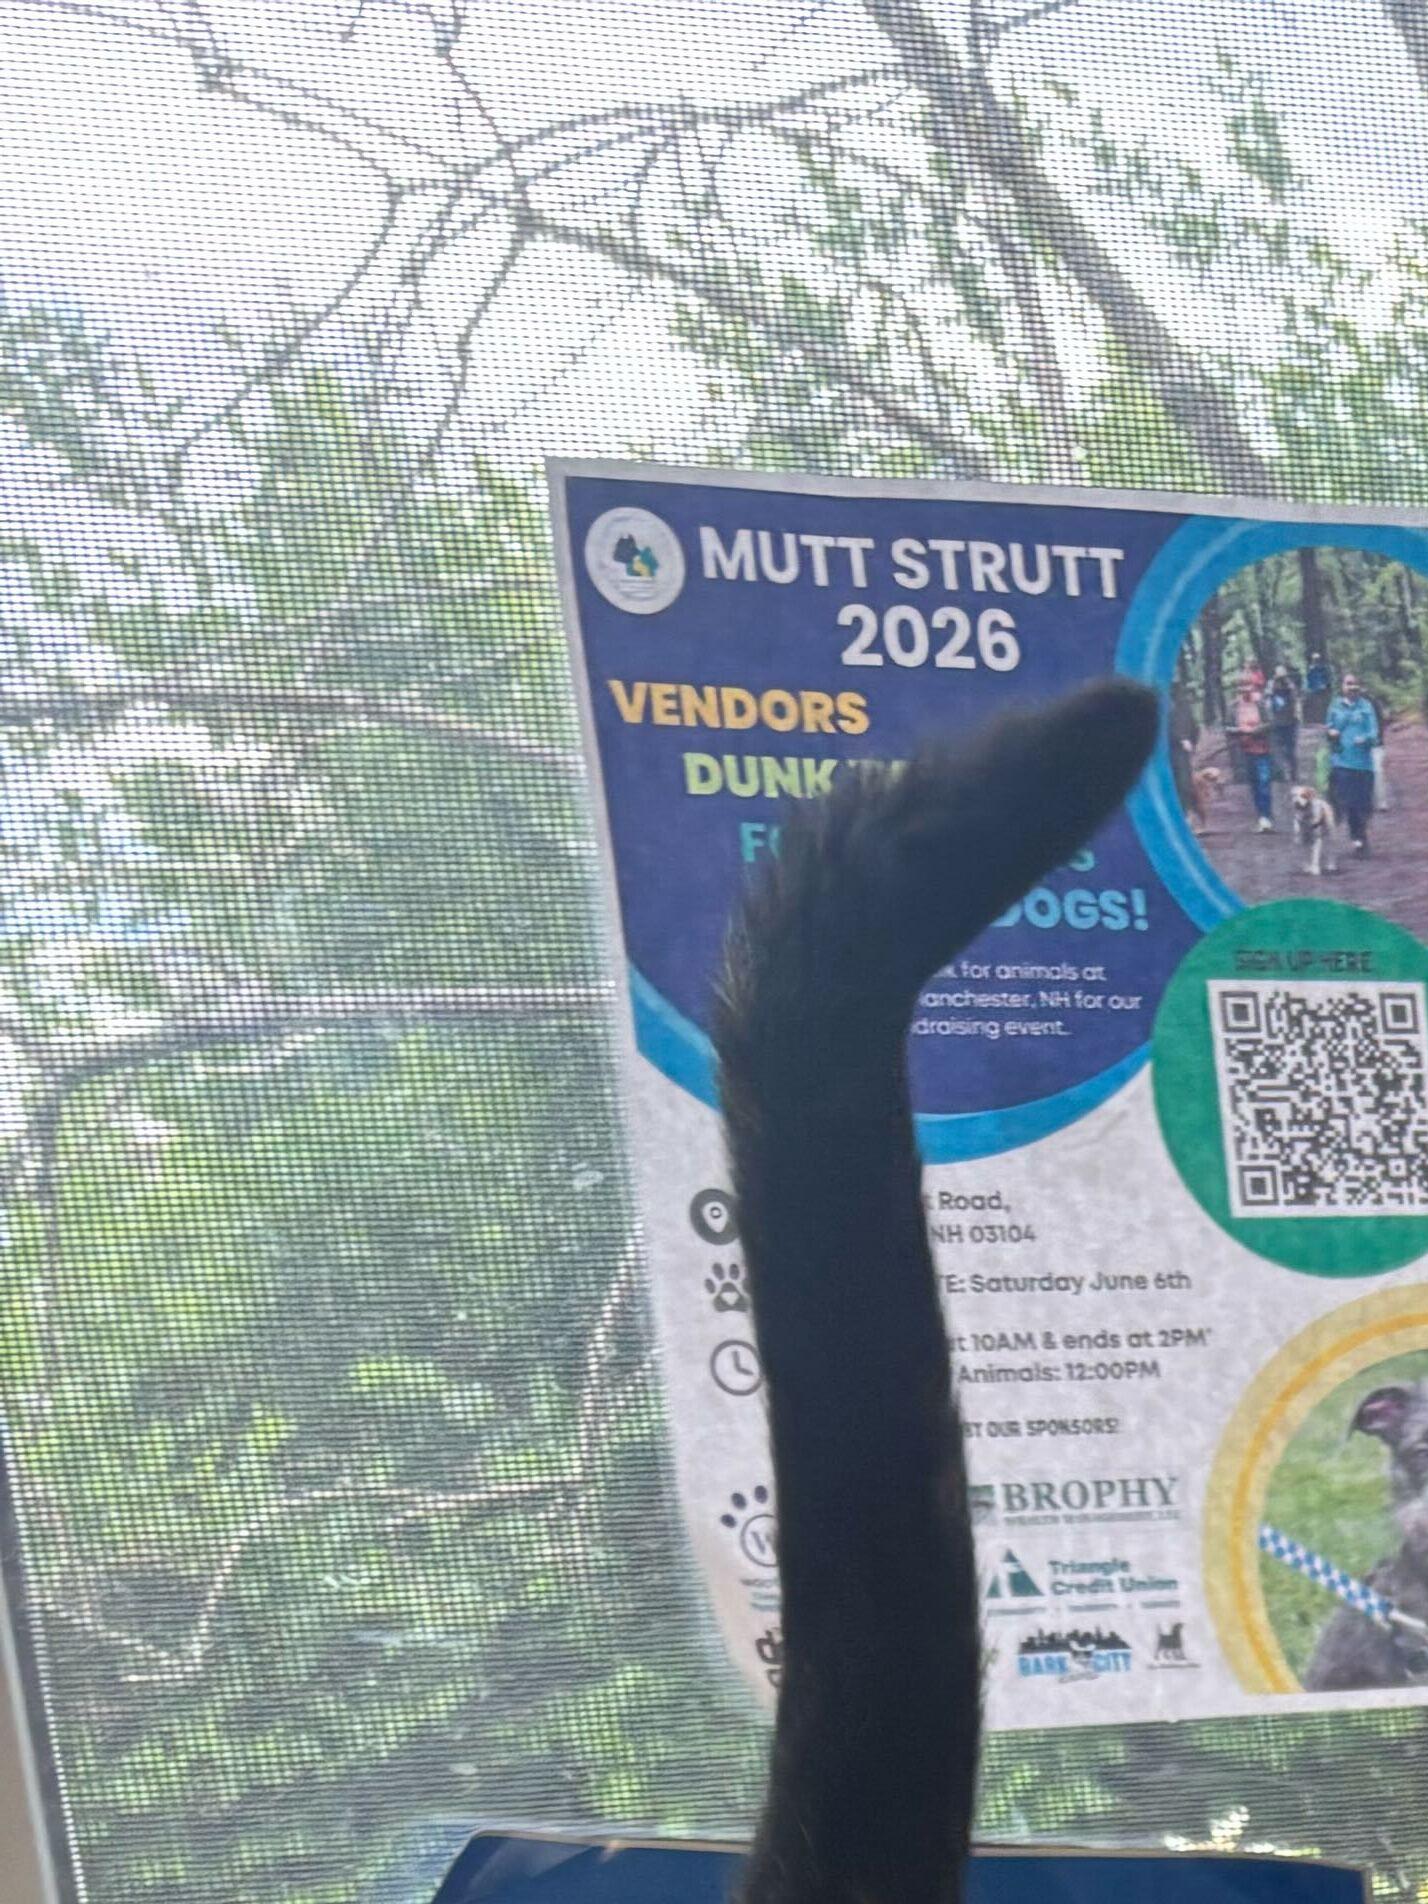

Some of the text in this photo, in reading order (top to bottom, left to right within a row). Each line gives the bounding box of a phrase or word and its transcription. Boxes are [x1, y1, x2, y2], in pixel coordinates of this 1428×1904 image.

[699, 526, 1125, 600] MUTT STRUTT
[837, 604, 1022, 671] 2026
[607, 680, 871, 735] VENDORS
[683, 752, 839, 799] DUNK
[961, 961, 991, 979] for
[995, 962, 1079, 981] animals
[1082, 964, 1106, 981] at
[1074, 991, 1104, 1010] for
[1108, 995, 1142, 1011] our
[911, 1017, 999, 1039] draising
[938, 1191, 1012, 1213] Road,
[969, 1225, 1036, 1243] 03104
[972, 1272, 1091, 1296] Saturday
[1090, 1273, 1149, 1291] June
[1154, 1271, 1192, 1290] 6th
[971, 1333, 1035, 1352] 10AM
[1042, 1333, 1057, 1350] &
[1062, 1331, 1121, 1350] ends
[1127, 1333, 1153, 1349] at
[958, 1361, 1161, 1384] Animals: 12:00PM
[1001, 1477, 1177, 1514] BROPHY
[1048, 1558, 1131, 1576] Triangle
[1051, 1576, 1178, 1596] Credit Union
